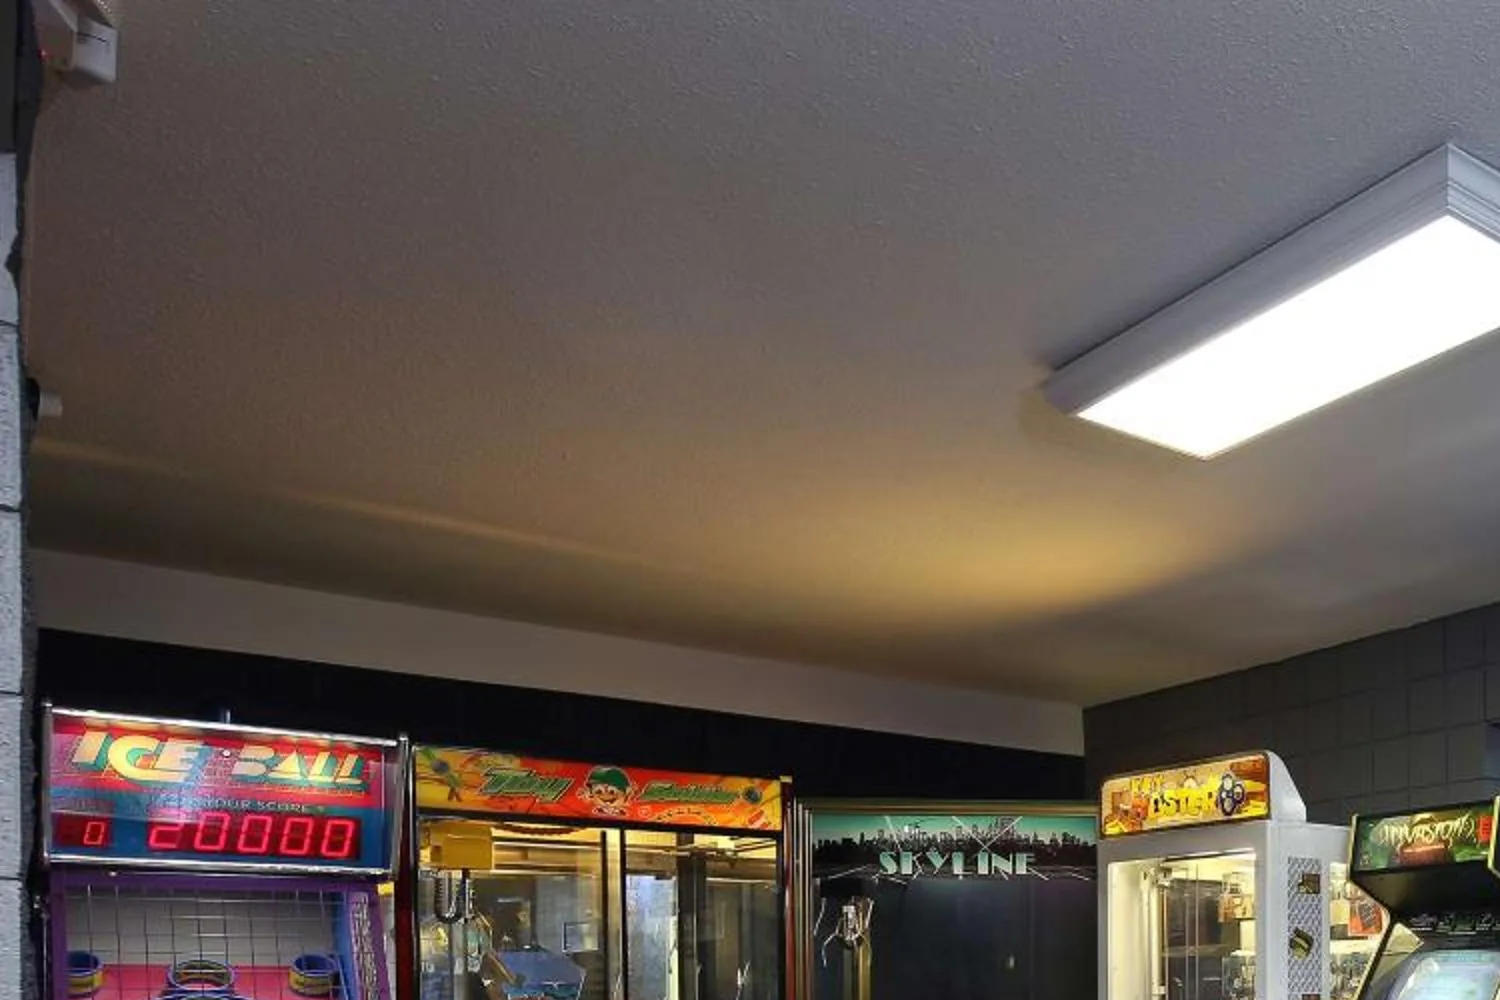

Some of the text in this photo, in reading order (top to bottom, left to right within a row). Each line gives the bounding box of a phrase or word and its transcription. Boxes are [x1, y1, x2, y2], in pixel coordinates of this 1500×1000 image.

[70, 731, 367, 786] ICE BALL
[83, 821, 105, 846] 0
[148, 811, 355, 857] 20000
[879, 851, 1038, 876] SKYLINE
